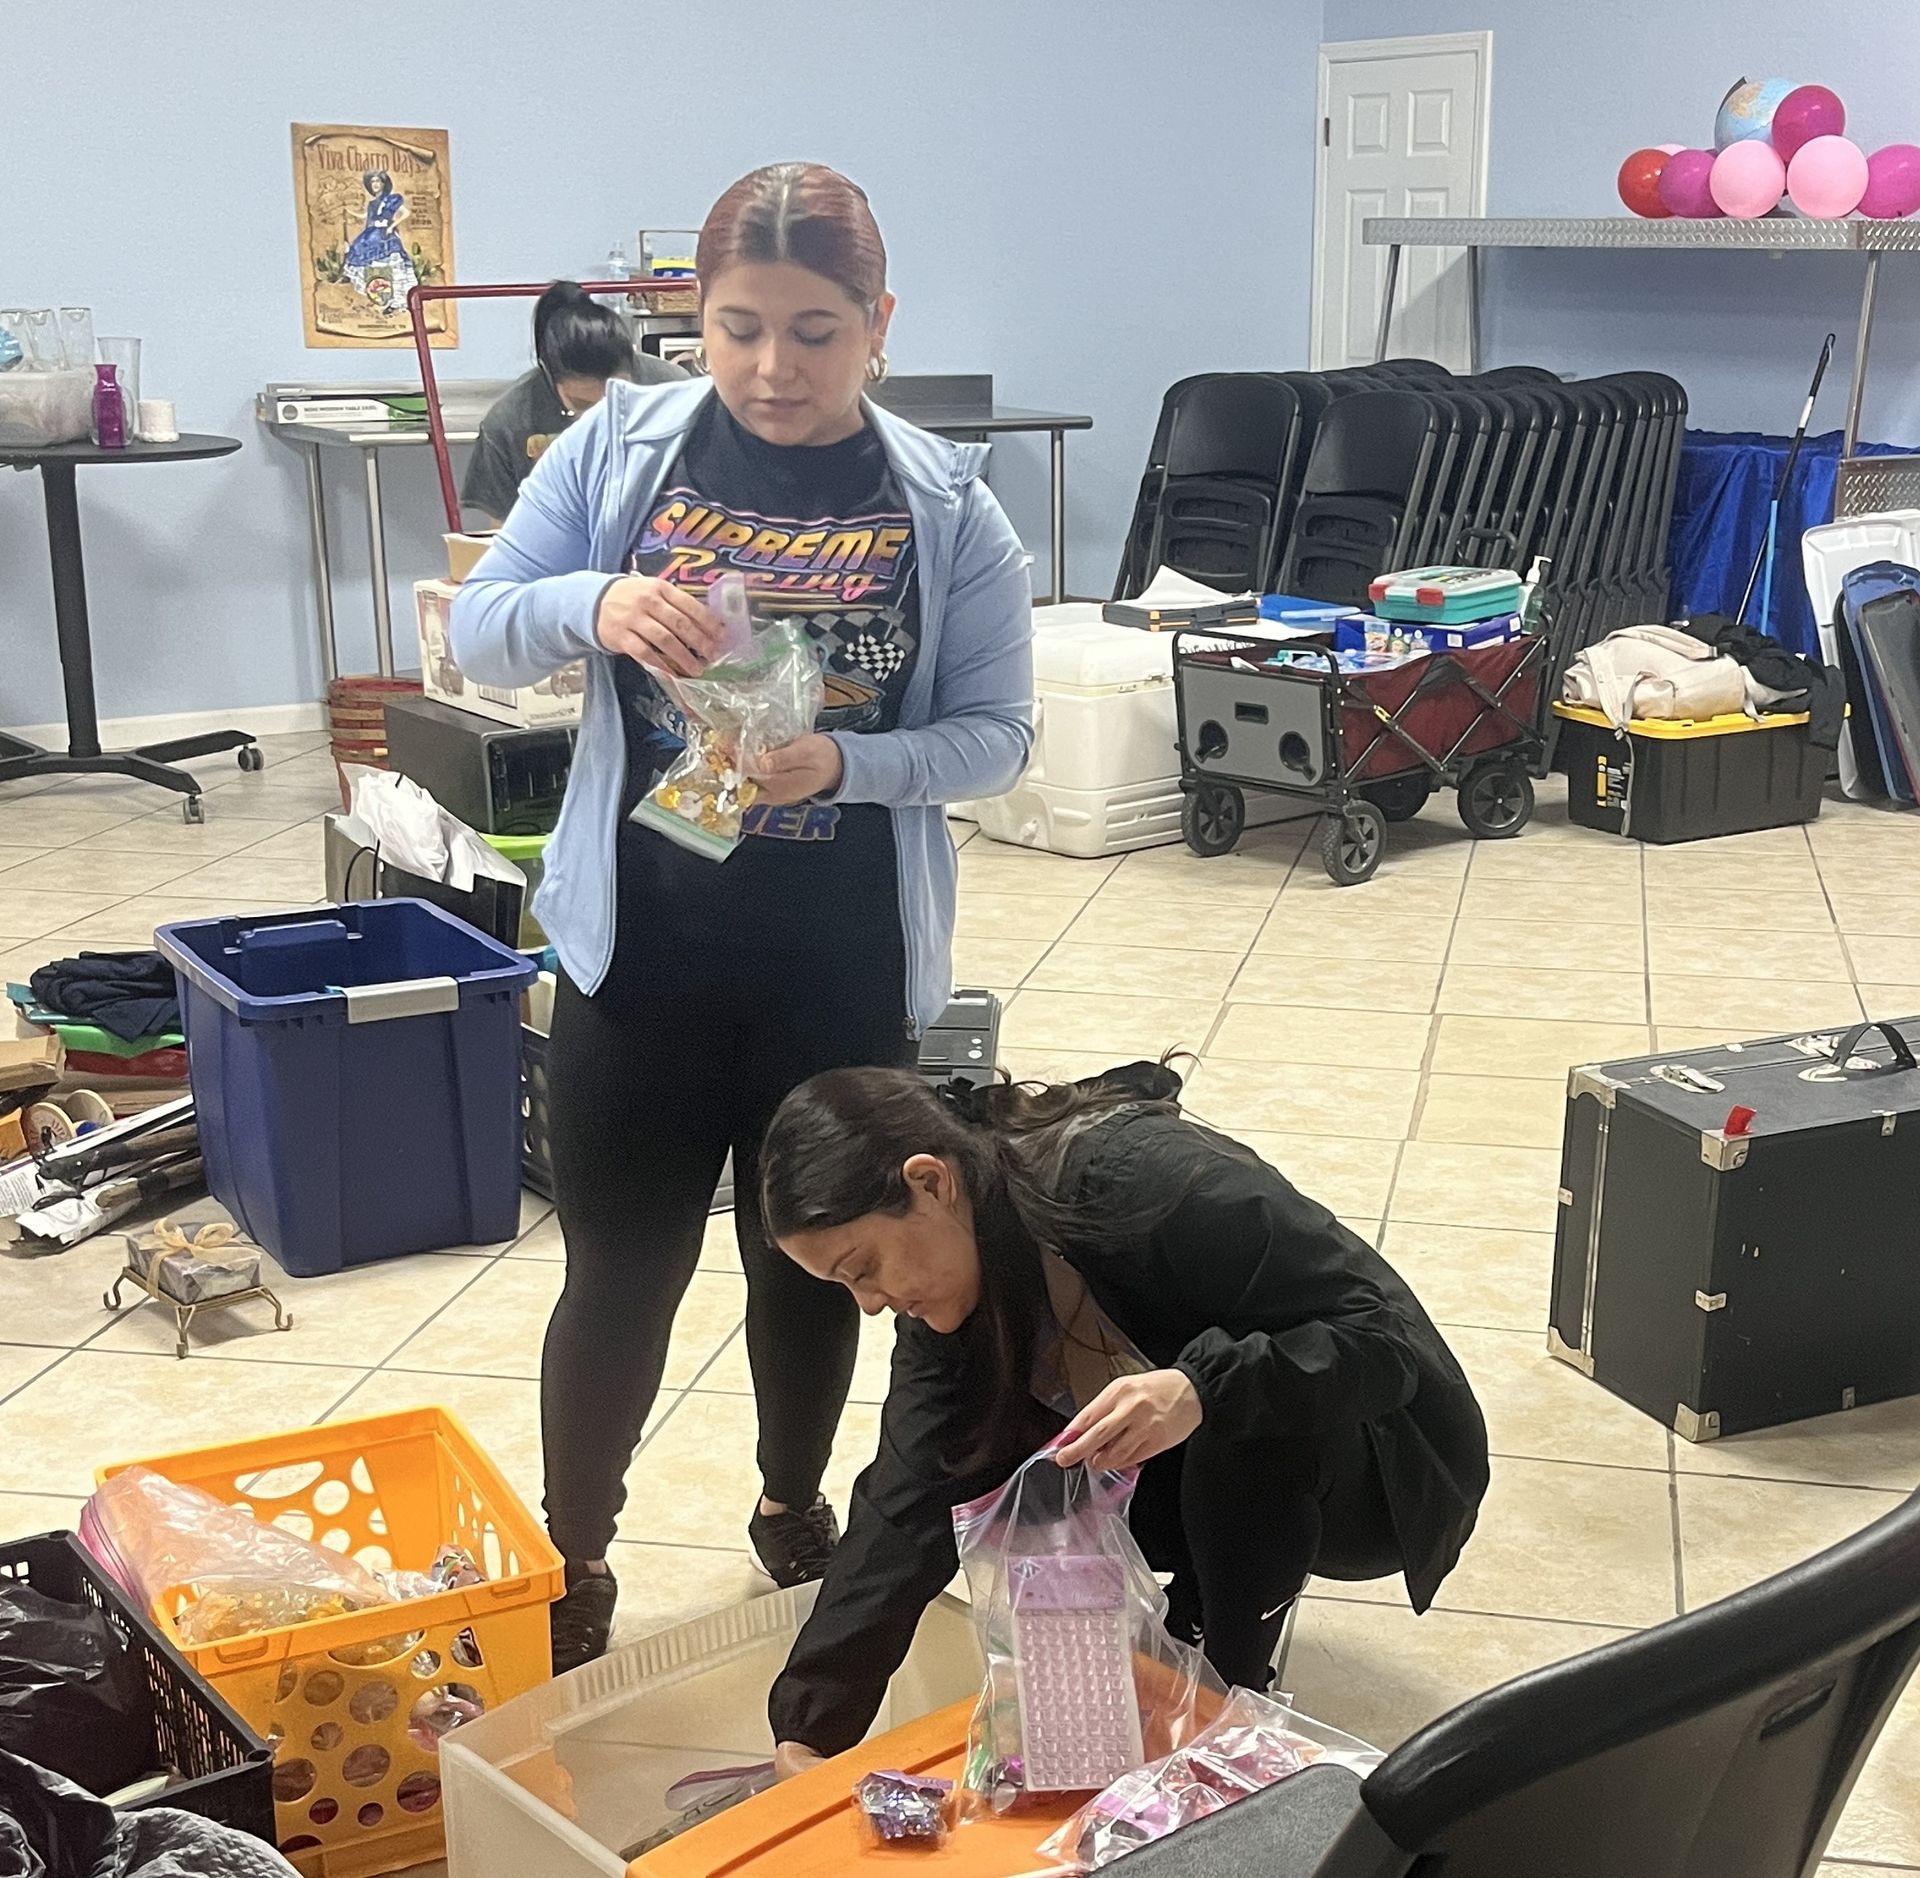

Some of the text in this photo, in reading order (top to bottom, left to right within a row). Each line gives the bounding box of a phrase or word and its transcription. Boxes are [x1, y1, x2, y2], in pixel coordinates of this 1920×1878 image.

[317, 144, 344, 171] Viva
[347, 145, 389, 172] Charro
[639, 502, 910, 575] SUPREME
